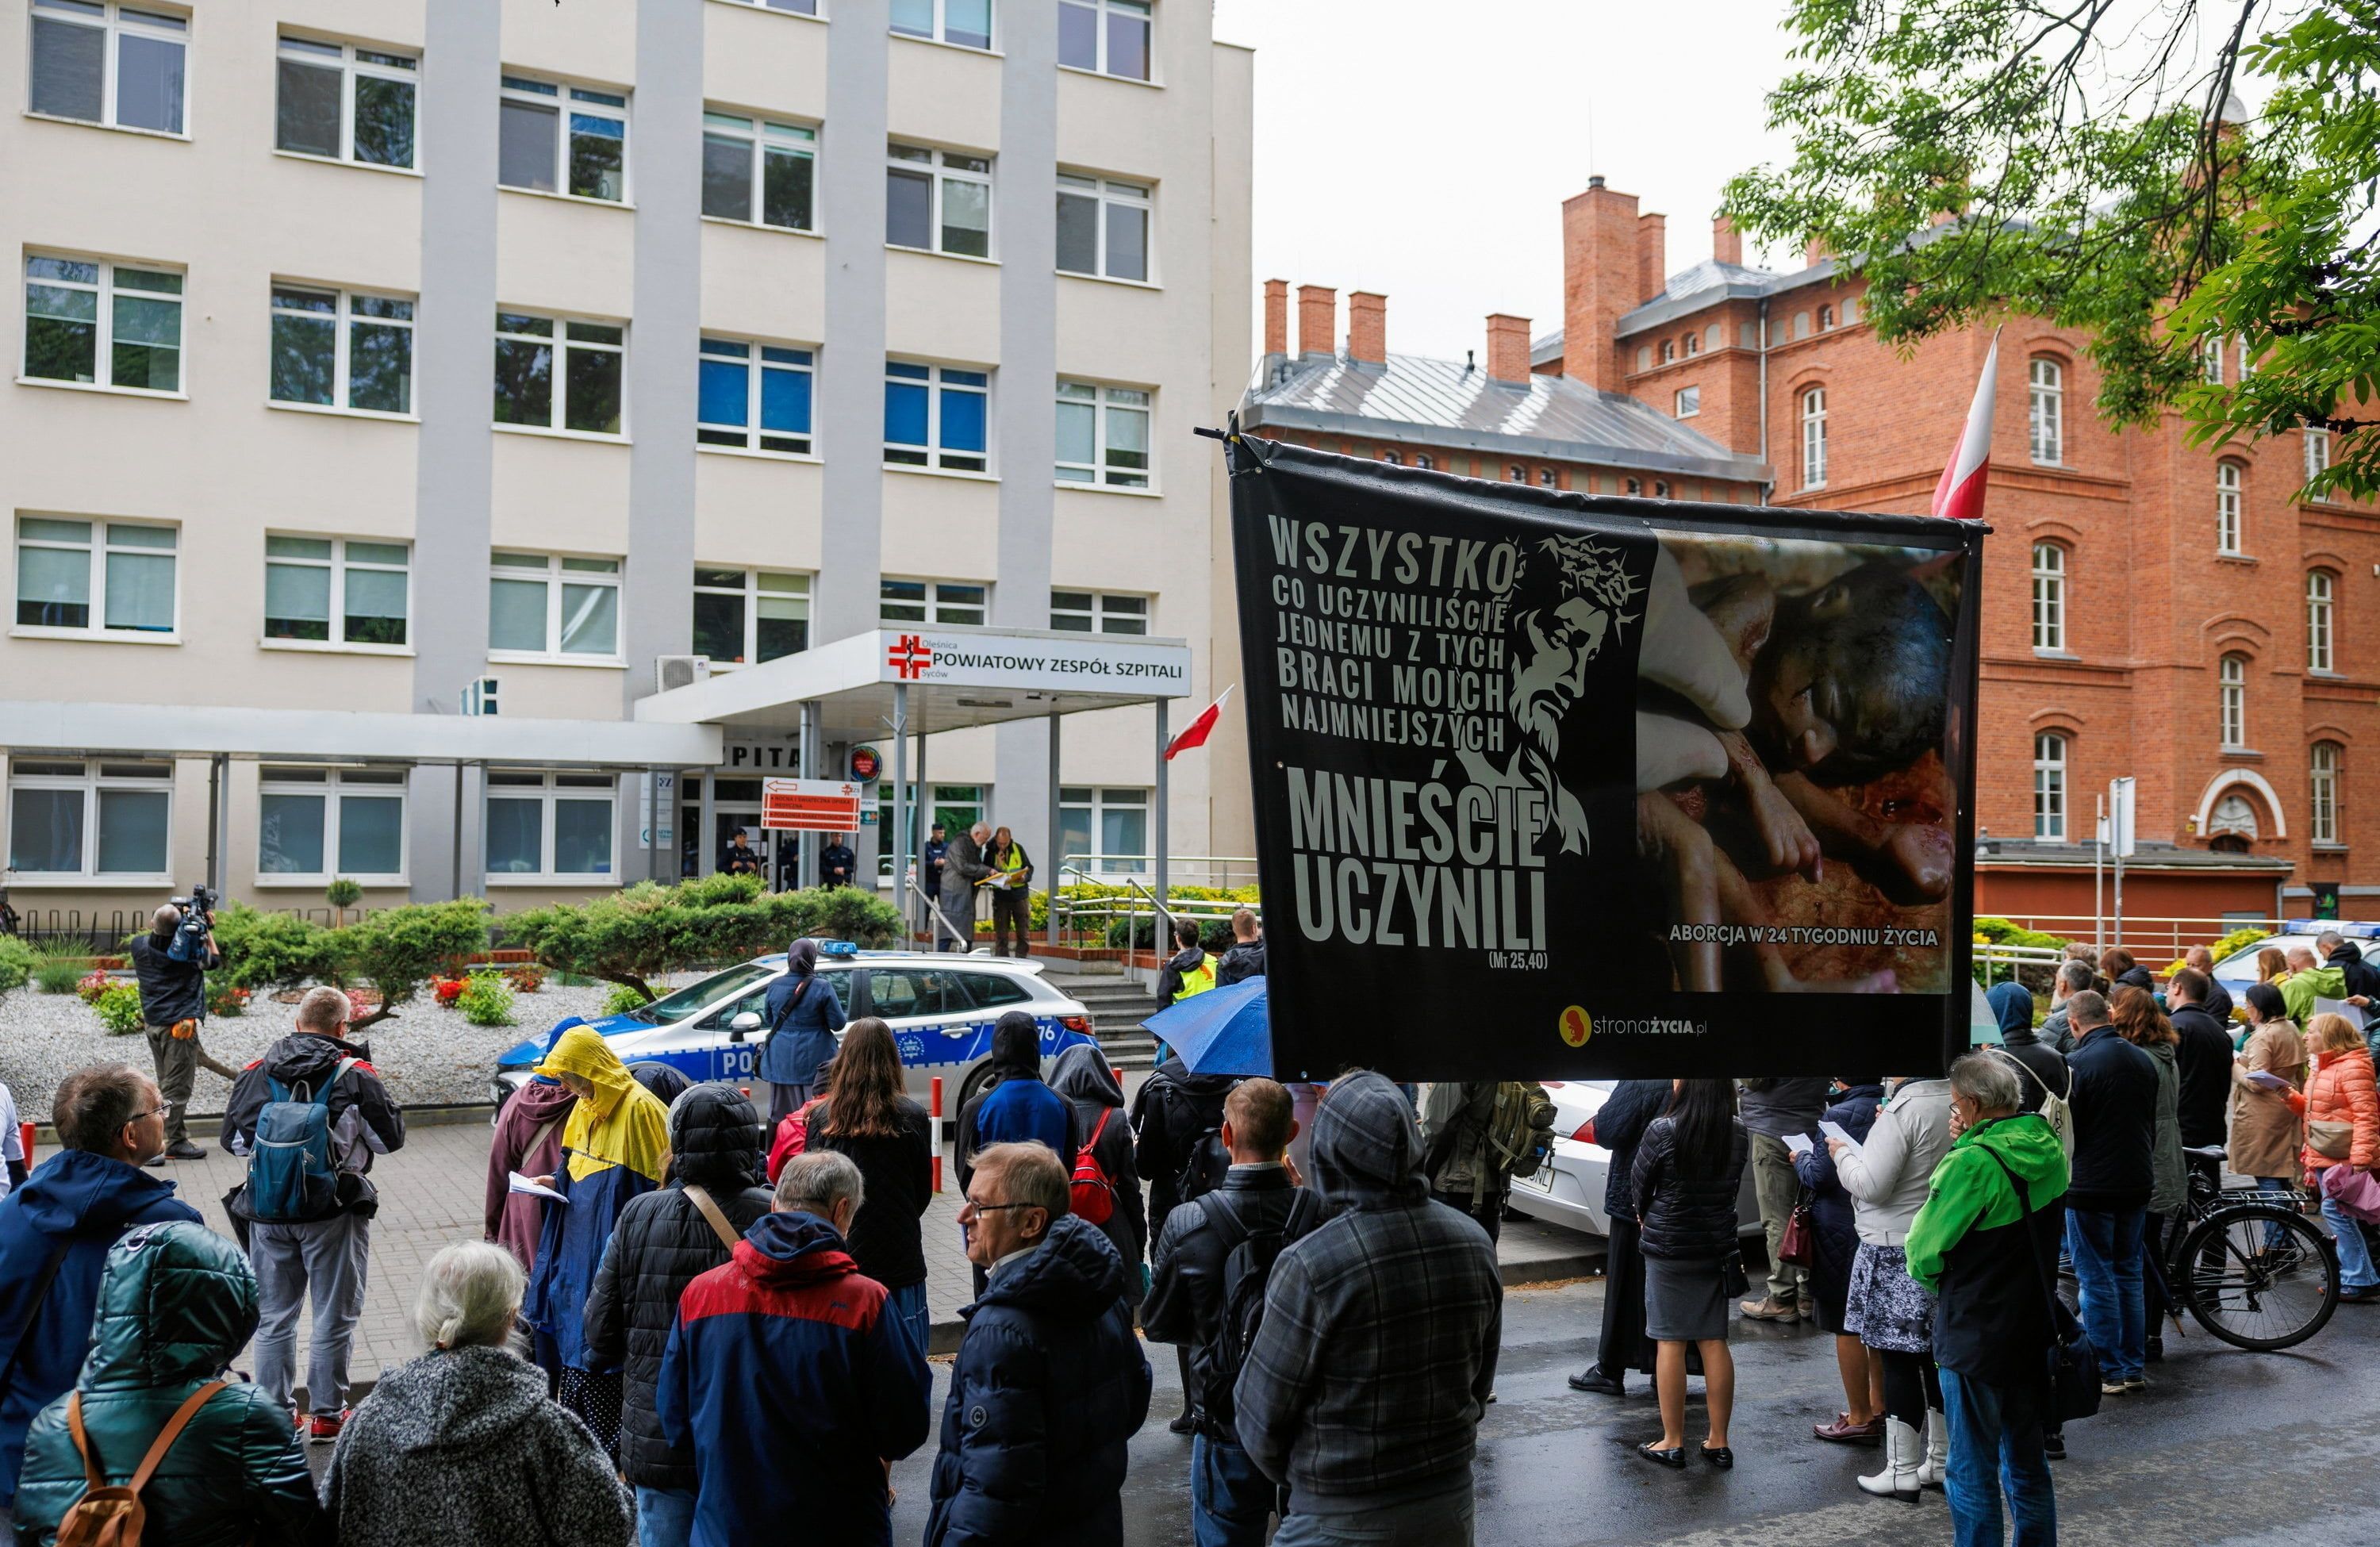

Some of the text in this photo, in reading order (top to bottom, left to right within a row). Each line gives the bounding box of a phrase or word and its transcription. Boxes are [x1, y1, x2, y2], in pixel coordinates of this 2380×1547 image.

[1269, 514, 1517, 594] WSZYSTKO
[1273, 574, 1507, 634] CO UCZYNILIŚCIE
[922, 639, 958, 649] Oleśnica
[1277, 611, 1505, 670] JEDNEMU Z TYCH
[921, 669, 948, 678] Syców
[933, 652, 1182, 678] POWIATOWY ZESPÓŁ SZPITALI
[1278, 647, 1505, 713] BRACI MOICH
[1281, 693, 1504, 752] NAJMNIEJSZYCH
[722, 747, 800, 768] PITA
[1287, 759, 1546, 868] MNIEŚCIE
[1293, 854, 1546, 951] UCZYNILI
[1669, 924, 1938, 946] ABORCJA W 24 TYGODNIU ŻYCIA
[1510, 951, 1548, 970] 25,40)
[1038, 1025, 1055, 1041] 76
[1593, 1015, 1707, 1037] stronaŻYCIA.pl
[723, 1051, 752, 1074] PO
